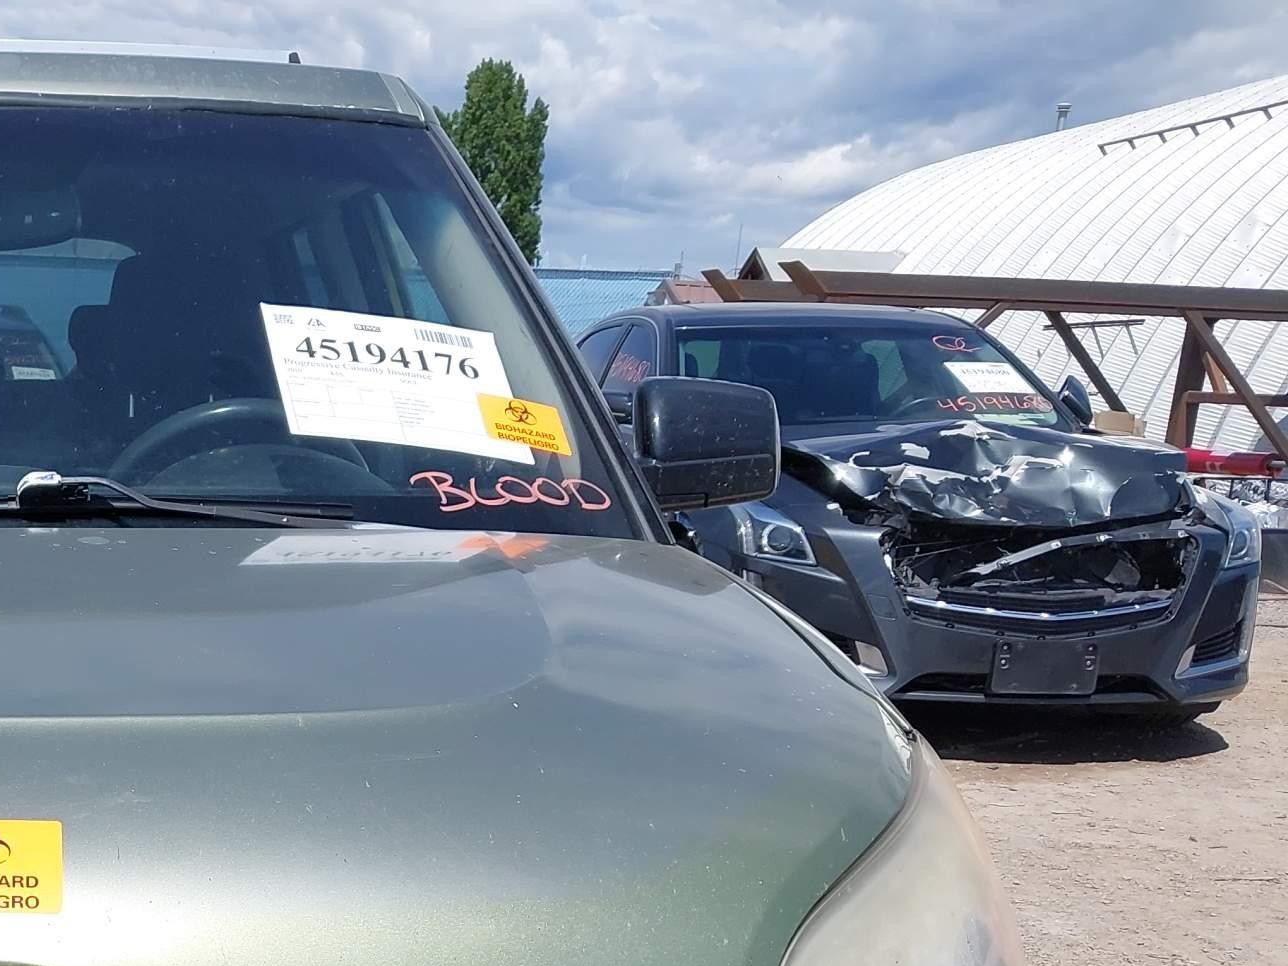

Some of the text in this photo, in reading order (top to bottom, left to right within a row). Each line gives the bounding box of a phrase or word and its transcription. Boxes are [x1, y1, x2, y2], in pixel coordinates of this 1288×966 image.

[296, 336, 479, 379] 45194176
[495, 422, 556, 441] BIOHAZARD
[497, 431, 560, 451] BIOPELIGRO
[410, 471, 611, 511] BLOOD
